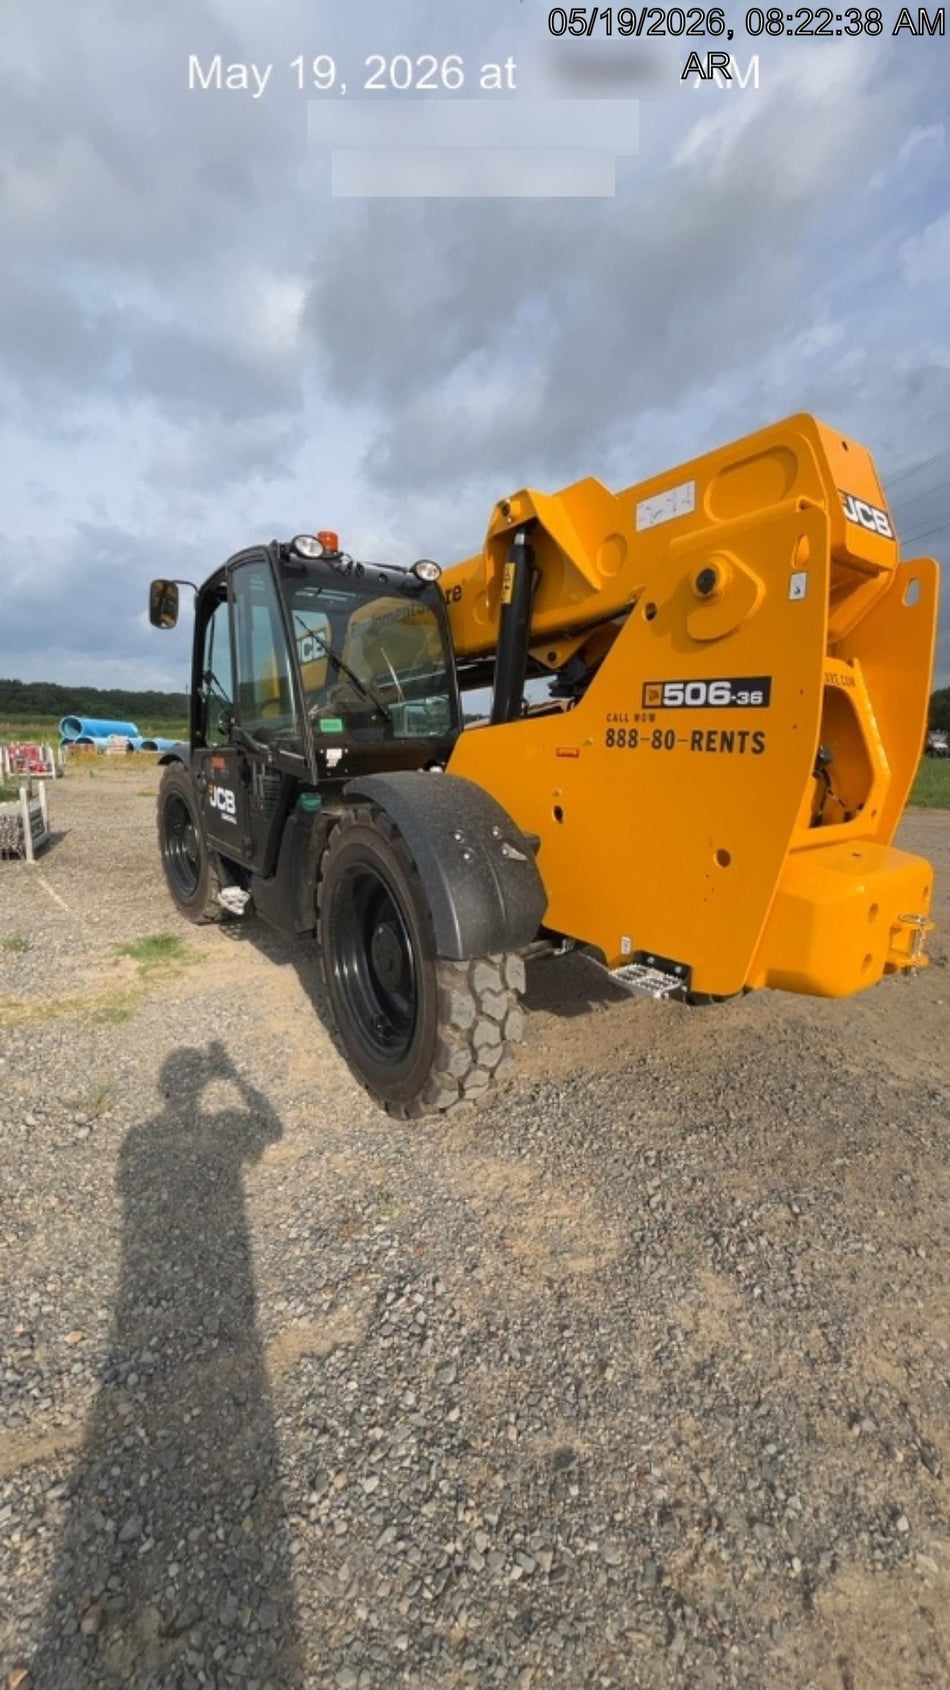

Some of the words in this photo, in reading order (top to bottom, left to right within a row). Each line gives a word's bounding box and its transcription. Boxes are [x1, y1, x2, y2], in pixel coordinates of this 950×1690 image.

[841, 495, 894, 538] JCB
[663, 681, 763, 707] 506-36
[606, 712, 629, 722] CALL
[634, 712, 656, 722] NOW
[605, 727, 766, 755] 888-80-RENTS
[209, 784, 236, 814] JCB
